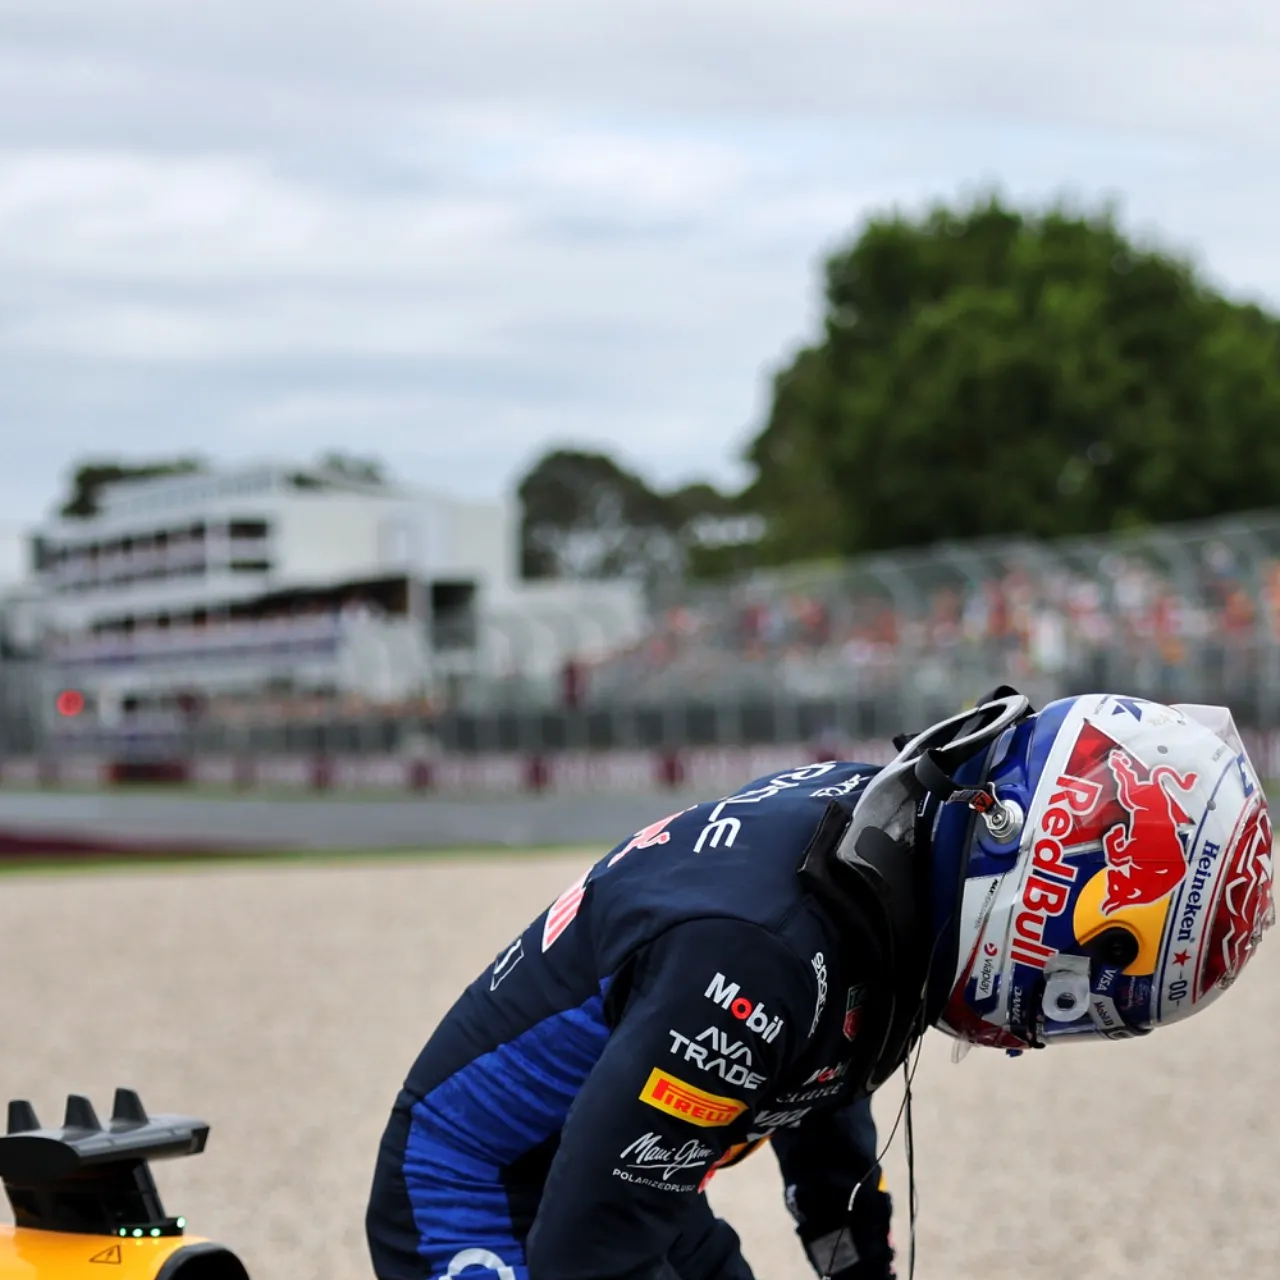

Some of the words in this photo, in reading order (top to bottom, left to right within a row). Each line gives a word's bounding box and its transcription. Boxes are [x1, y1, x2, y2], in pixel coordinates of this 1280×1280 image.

[1177, 839, 1221, 942] Heineken
[979, 958, 994, 994] viaplay
[1096, 968, 1118, 991] VISA
[703, 970, 785, 1045] Mobil
[669, 1029, 768, 1091] TRADE
[694, 1025, 753, 1067] AVA
[620, 1132, 673, 1165] Maui
